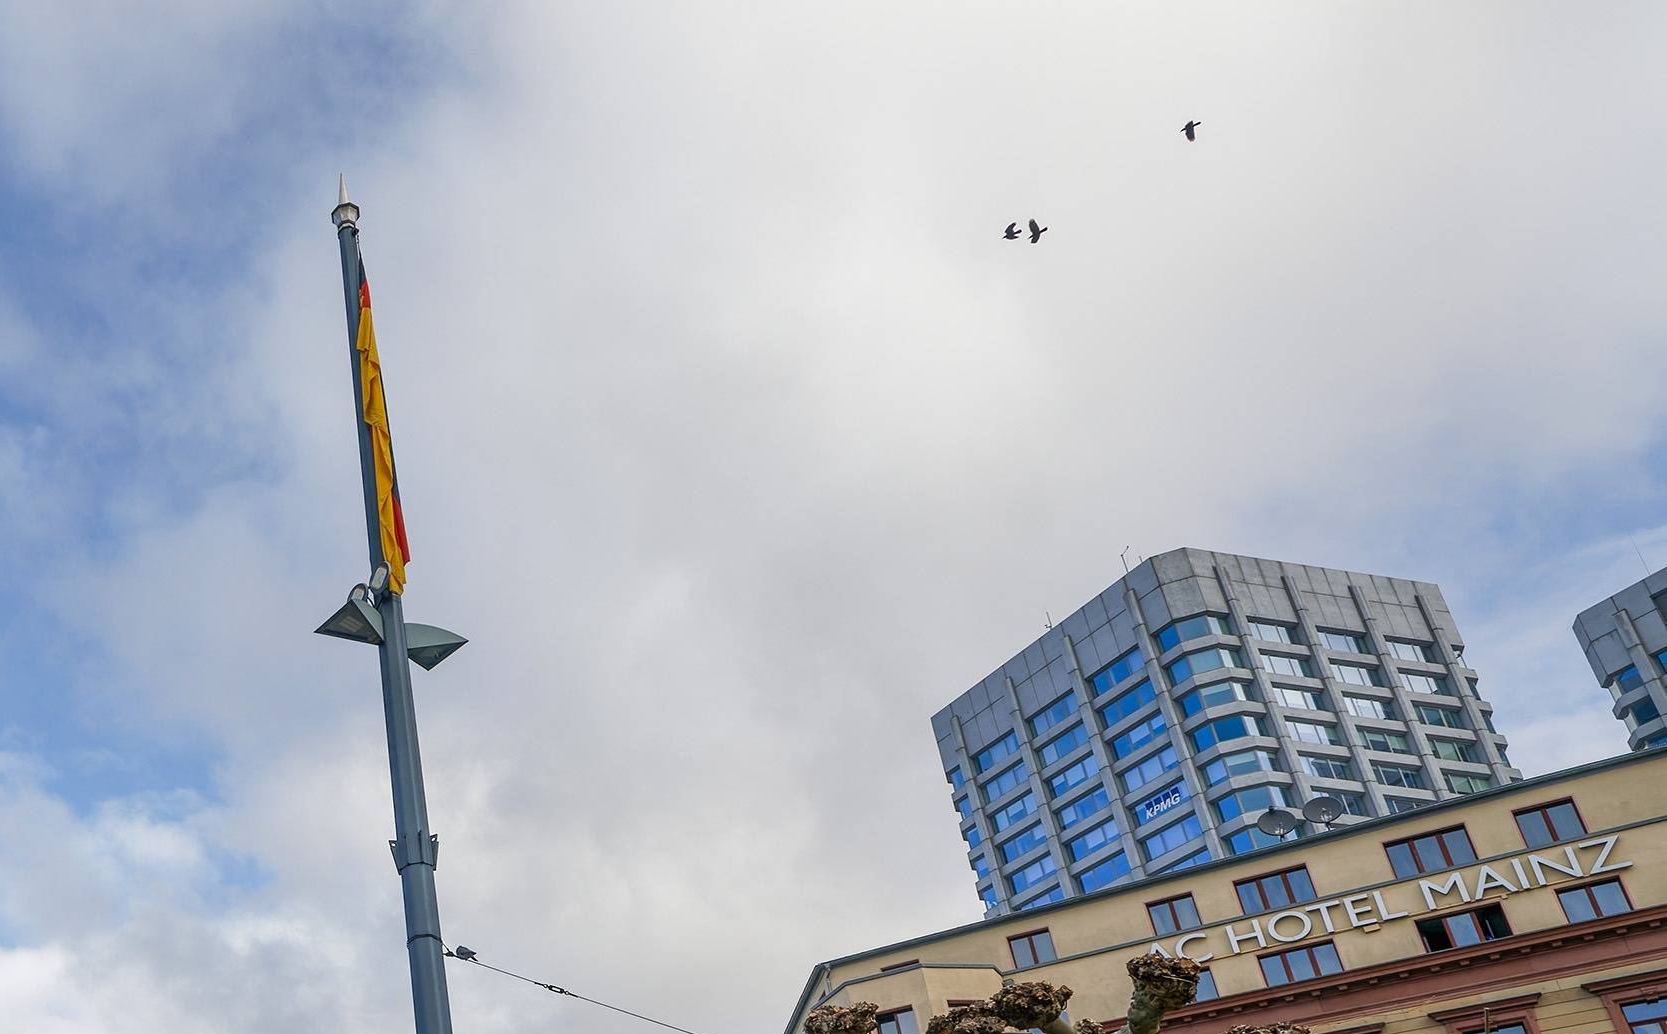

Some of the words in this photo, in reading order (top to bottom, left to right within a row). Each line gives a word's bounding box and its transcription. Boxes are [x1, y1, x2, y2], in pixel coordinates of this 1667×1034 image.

[1146, 793, 1181, 819] KPMG
[1224, 890, 1410, 954] HOTEL
[1419, 833, 1633, 911] MAINZ
